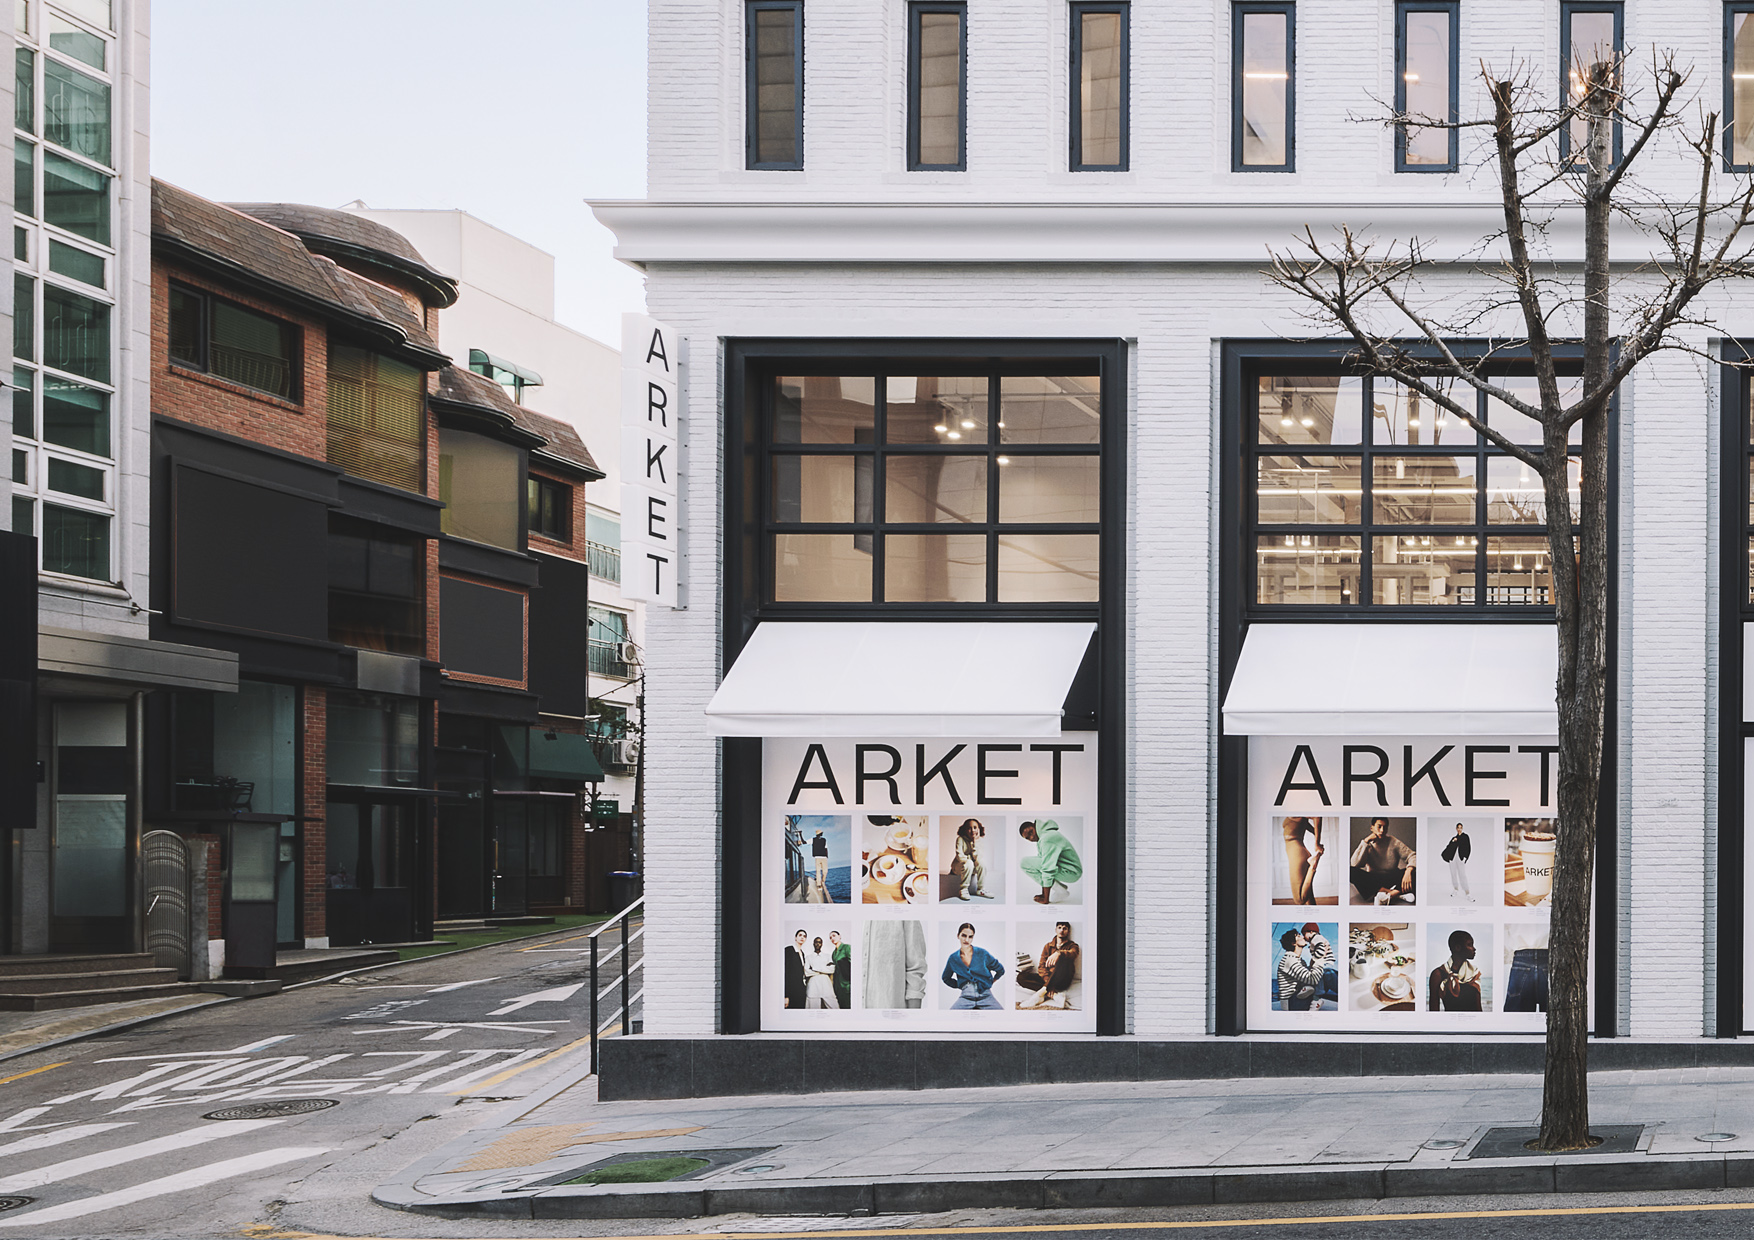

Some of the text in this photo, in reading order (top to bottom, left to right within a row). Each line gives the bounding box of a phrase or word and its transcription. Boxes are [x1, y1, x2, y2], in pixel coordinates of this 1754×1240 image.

[646, 328, 670, 595] ARKET
[786, 743, 1085, 806] ARKET
[1273, 744, 1559, 807] ARKET
